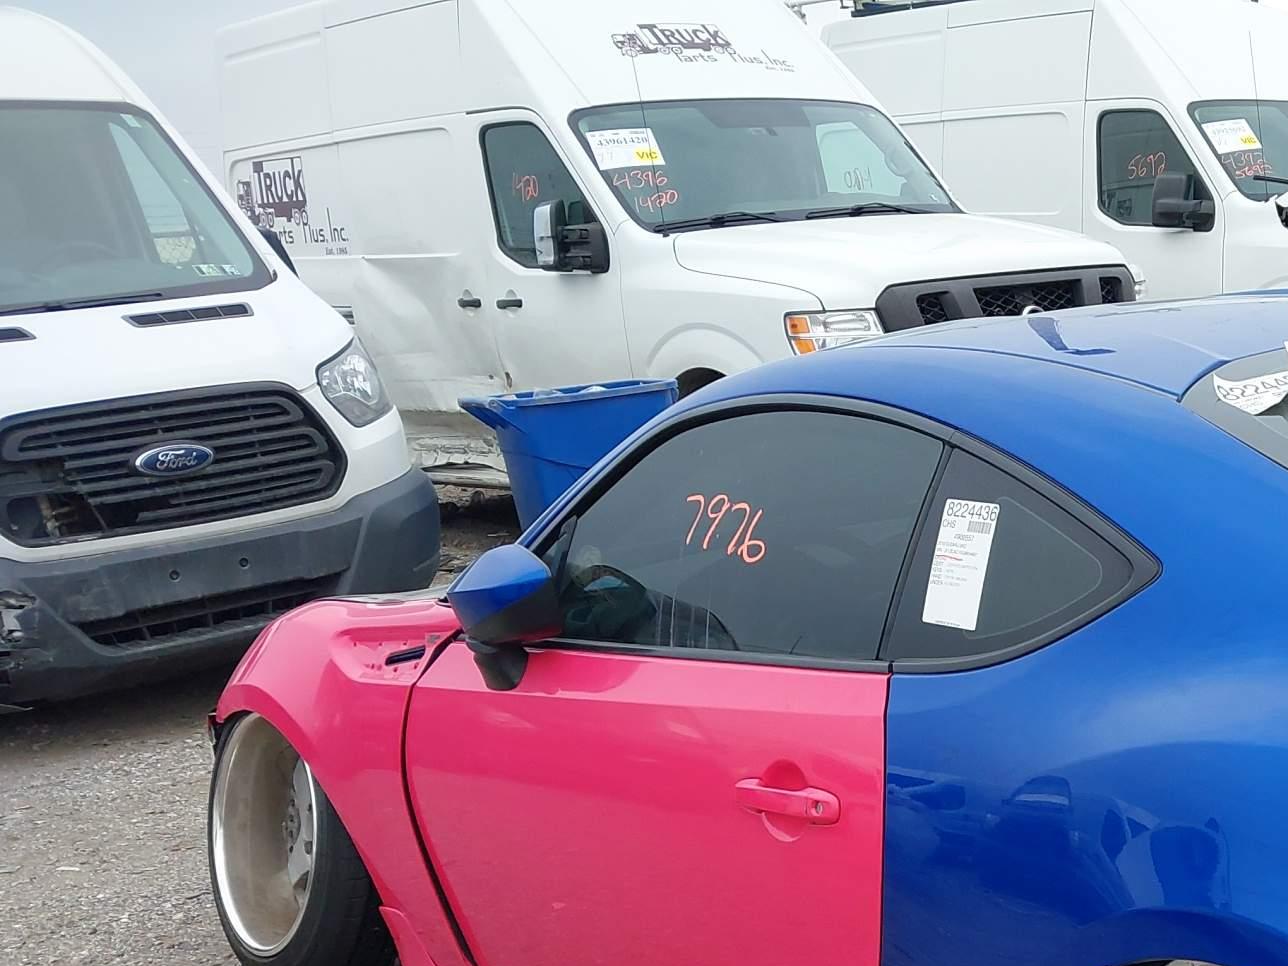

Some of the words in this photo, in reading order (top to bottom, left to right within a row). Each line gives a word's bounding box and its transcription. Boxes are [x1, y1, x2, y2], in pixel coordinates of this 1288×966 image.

[637, 23, 732, 47] TRUCK
[636, 151, 659, 160] VIC
[1127, 151, 1166, 180] 5692
[252, 157, 307, 204] TRUCK
[612, 170, 668, 190] 4396
[634, 189, 679, 213] 1420
[156, 449, 197, 470] Ford
[946, 501, 999, 522] 8224436
[686, 494, 766, 563] 7976
[942, 518, 957, 529] CHS
